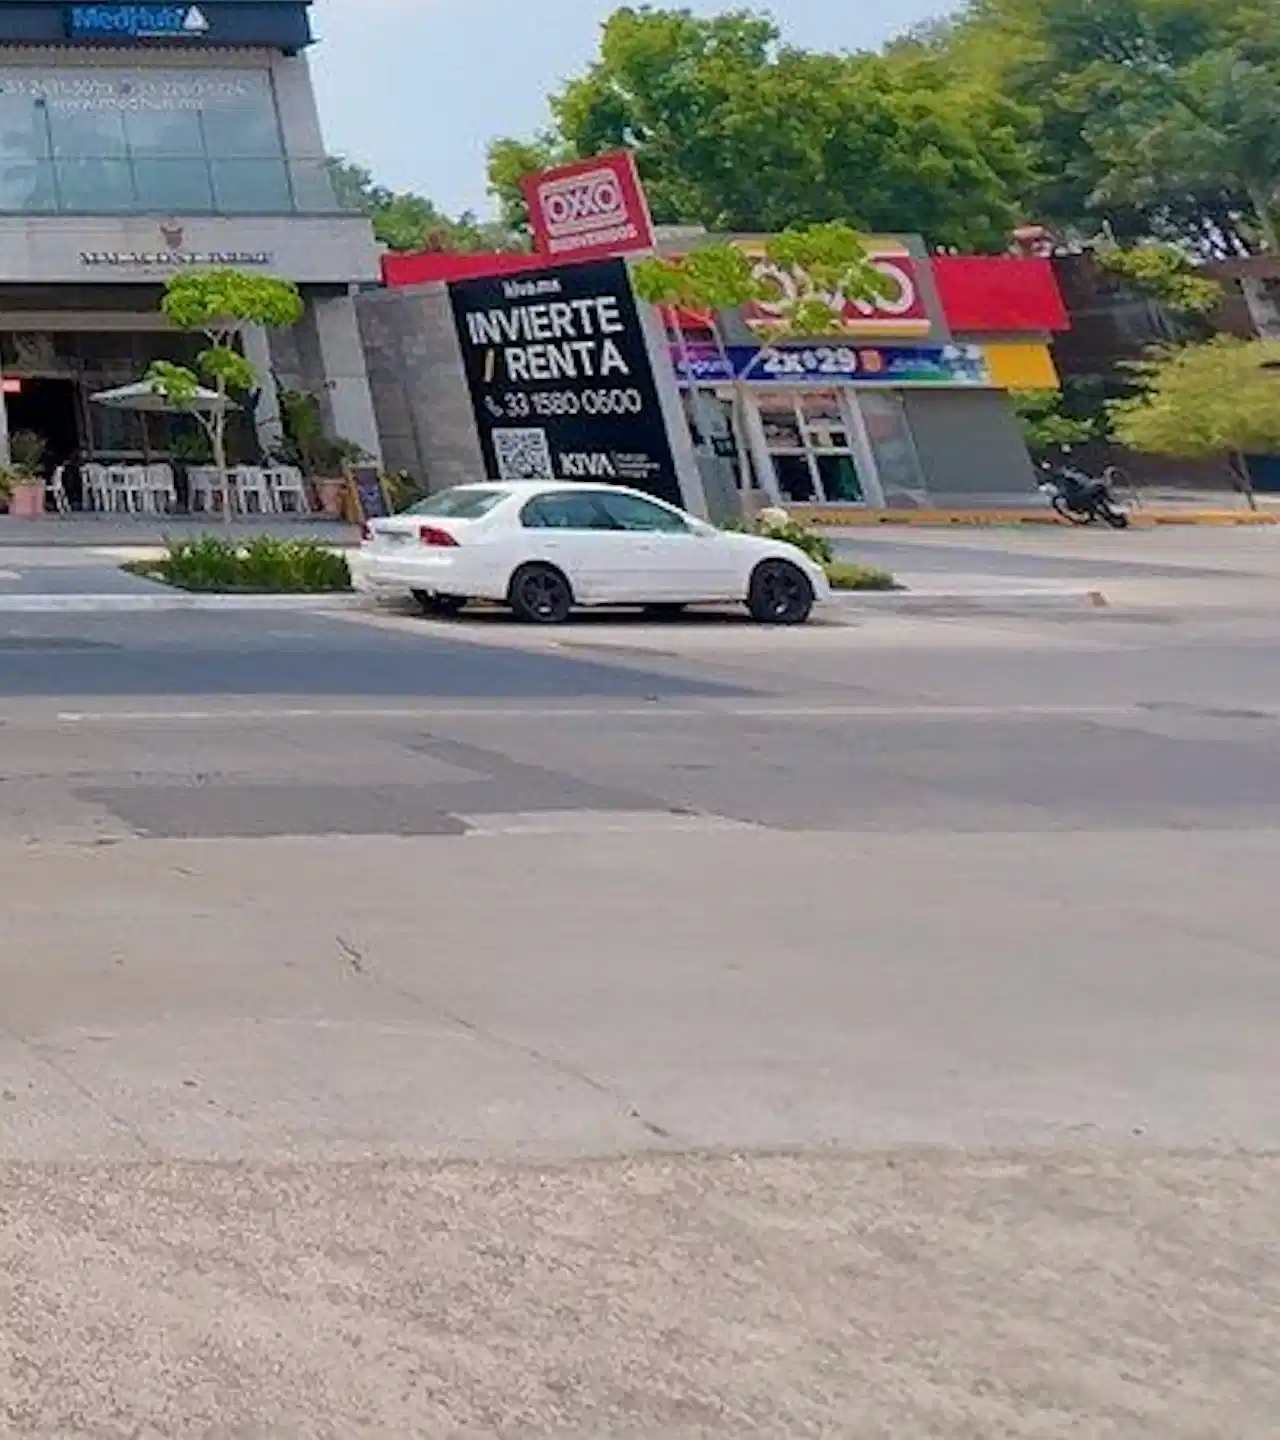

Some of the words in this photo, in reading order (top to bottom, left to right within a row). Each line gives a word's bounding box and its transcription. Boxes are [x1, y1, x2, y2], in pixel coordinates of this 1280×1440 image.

[544, 180, 618, 222] OXXO
[466, 296, 625, 345] INVIERTE
[504, 338, 631, 382] RENTA
[504, 391, 530, 417] 33
[559, 452, 616, 476] KIVA
